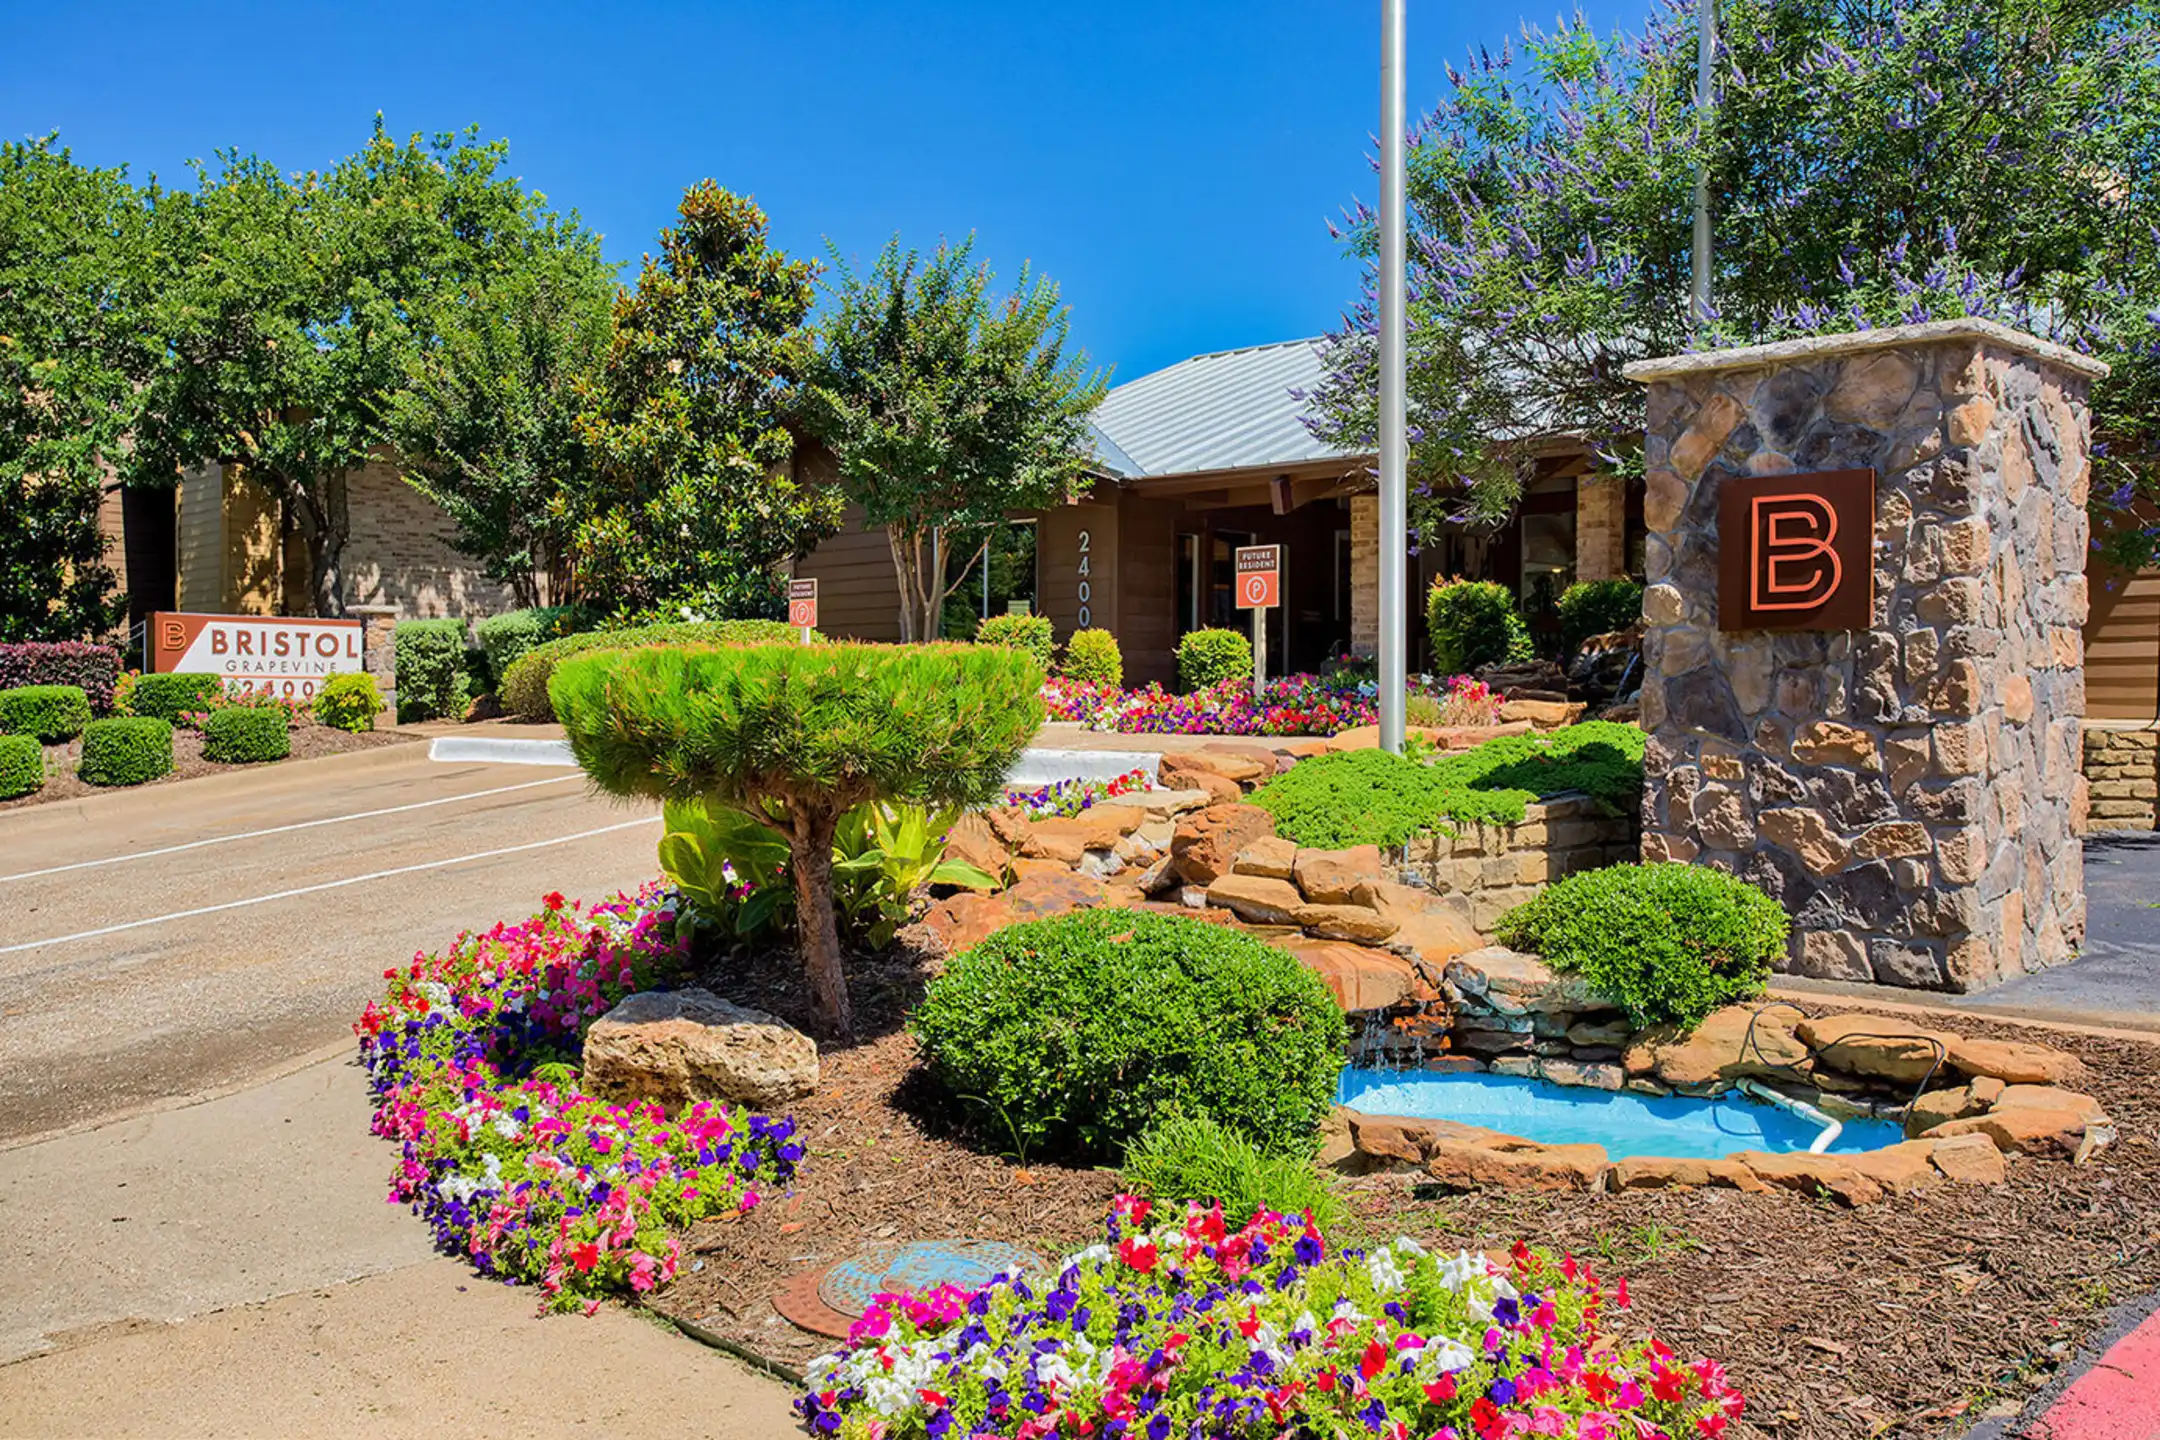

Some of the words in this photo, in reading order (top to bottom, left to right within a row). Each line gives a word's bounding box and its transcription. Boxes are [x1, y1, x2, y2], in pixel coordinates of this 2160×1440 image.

[1751, 493, 1842, 611] B
[1078, 531, 1090, 627] 2400
[1252, 582, 1261, 598] P
[163, 620, 187, 650] B
[211, 629, 358, 658] BRISTOL
[225, 659, 337, 673] GRAPEVINE
